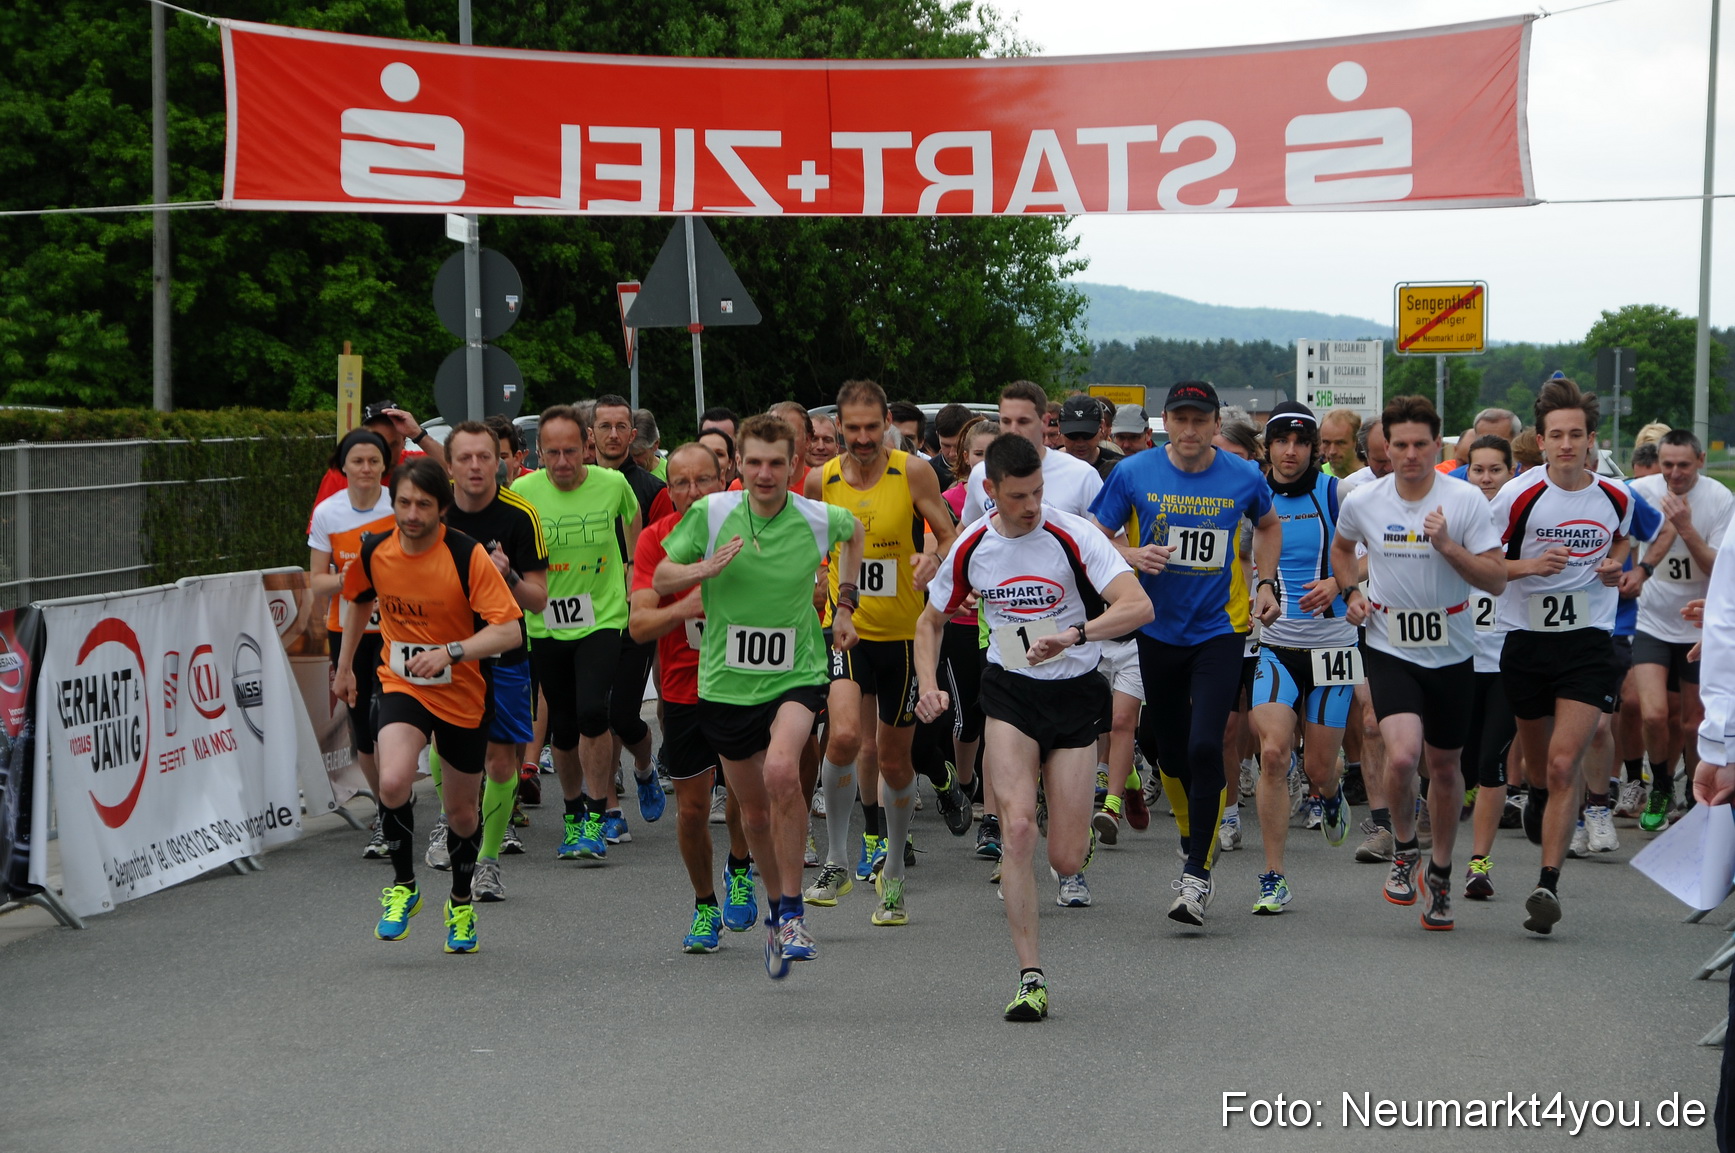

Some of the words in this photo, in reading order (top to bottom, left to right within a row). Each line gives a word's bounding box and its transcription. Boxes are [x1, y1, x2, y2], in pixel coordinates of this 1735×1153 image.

[1406, 293, 1477, 315] Sengenthal
[1415, 316, 1431, 325] am
[1435, 315, 1466, 327] Anger
[1422, 333, 1454, 342] Neumarkt
[1316, 389, 1333, 407] SHB
[1146, 492, 1161, 503] 10.
[1163, 494, 1235, 509] NEUMARKTER
[1160, 503, 1221, 517] STADTLAUF
[1536, 528, 1598, 538] GERHART
[1179, 530, 1216, 563] 119
[1669, 557, 1691, 580] 31
[981, 586, 1044, 600] GERHART
[550, 597, 584, 624] 112
[1476, 598, 1496, 626] 2
[1542, 595, 1577, 627] 24
[1397, 612, 1442, 642] 106
[736, 630, 786, 665] 100
[1321, 651, 1353, 681] 141
[91, 715, 142, 774] JÄNIG
[151, 843, 173, 871] Tel.
